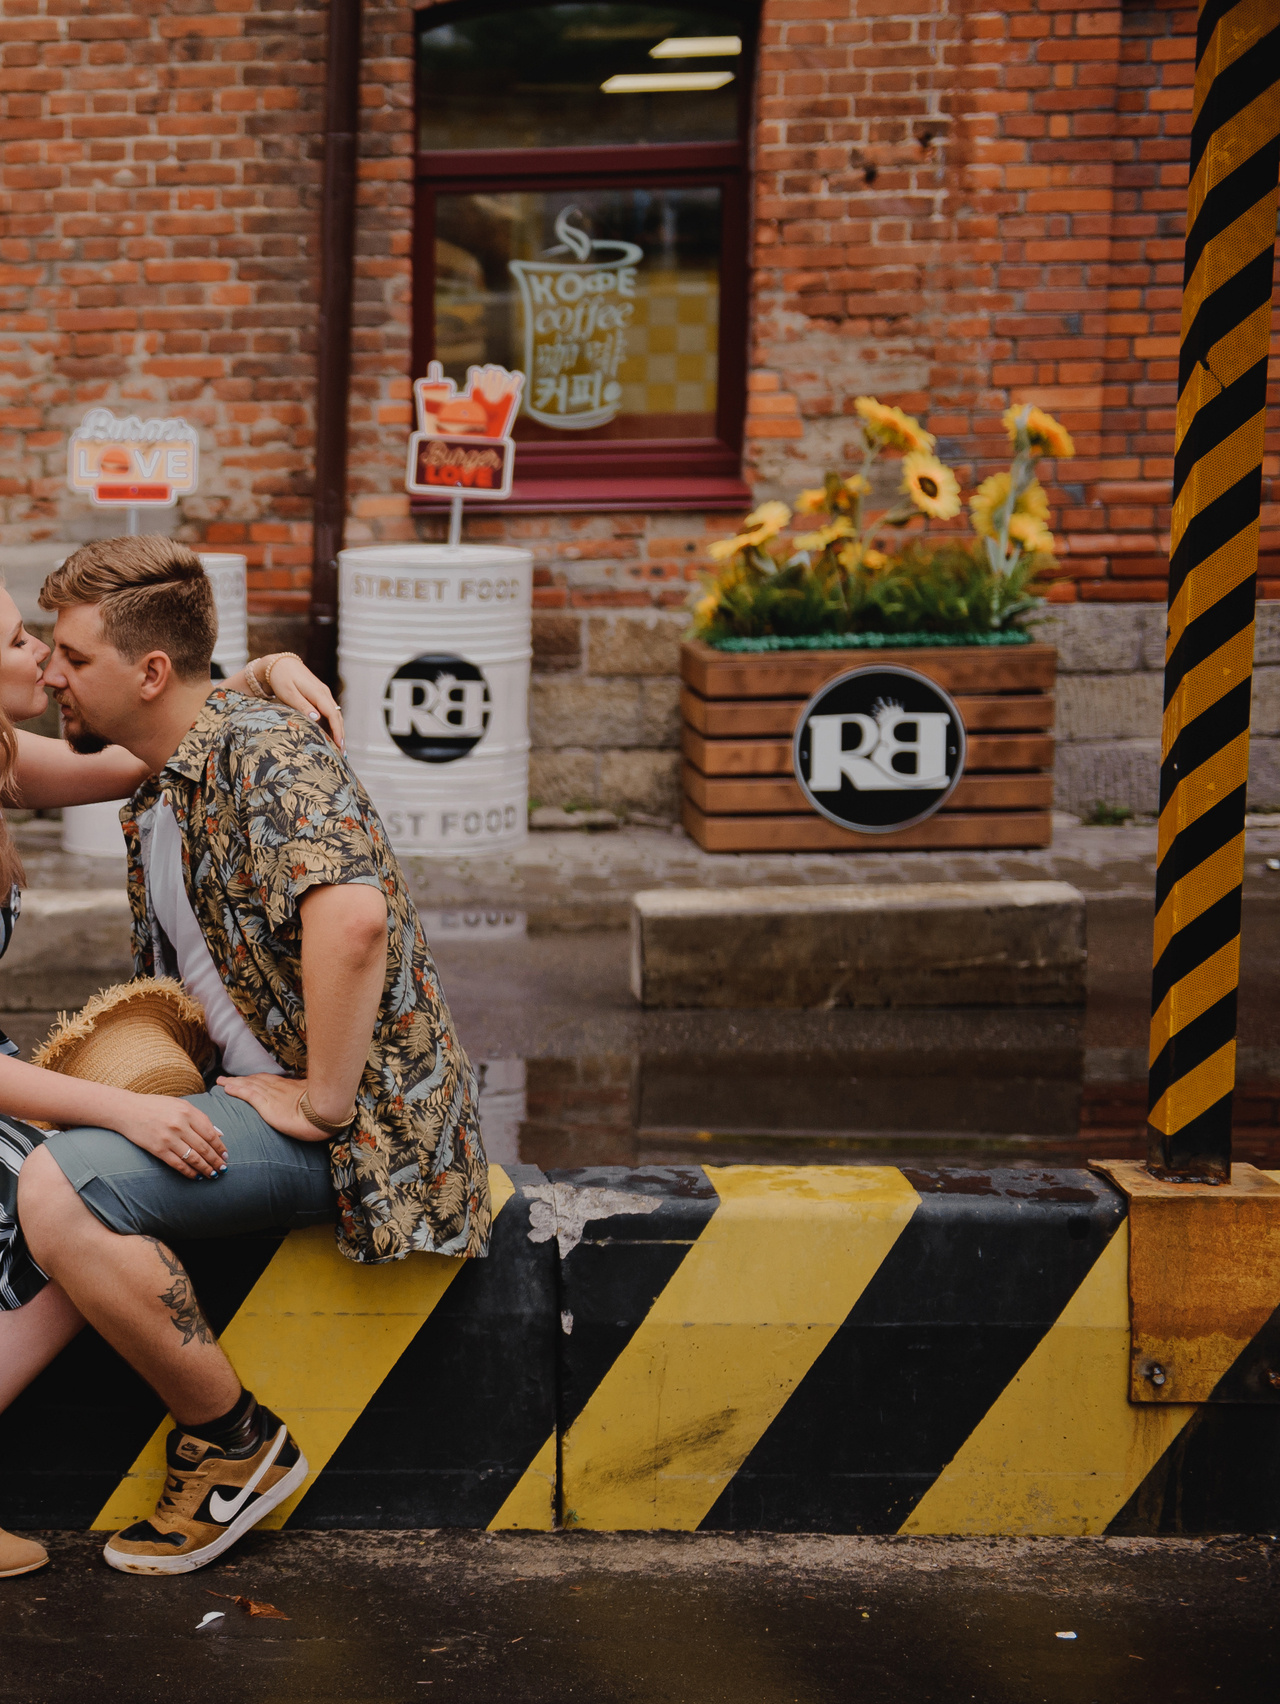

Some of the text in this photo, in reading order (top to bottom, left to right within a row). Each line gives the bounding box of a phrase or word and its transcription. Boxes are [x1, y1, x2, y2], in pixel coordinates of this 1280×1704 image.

[424, 464, 494, 489] LOVE
[353, 573, 520, 602] STREET FOOD
[440, 806, 517, 837] FOOD
